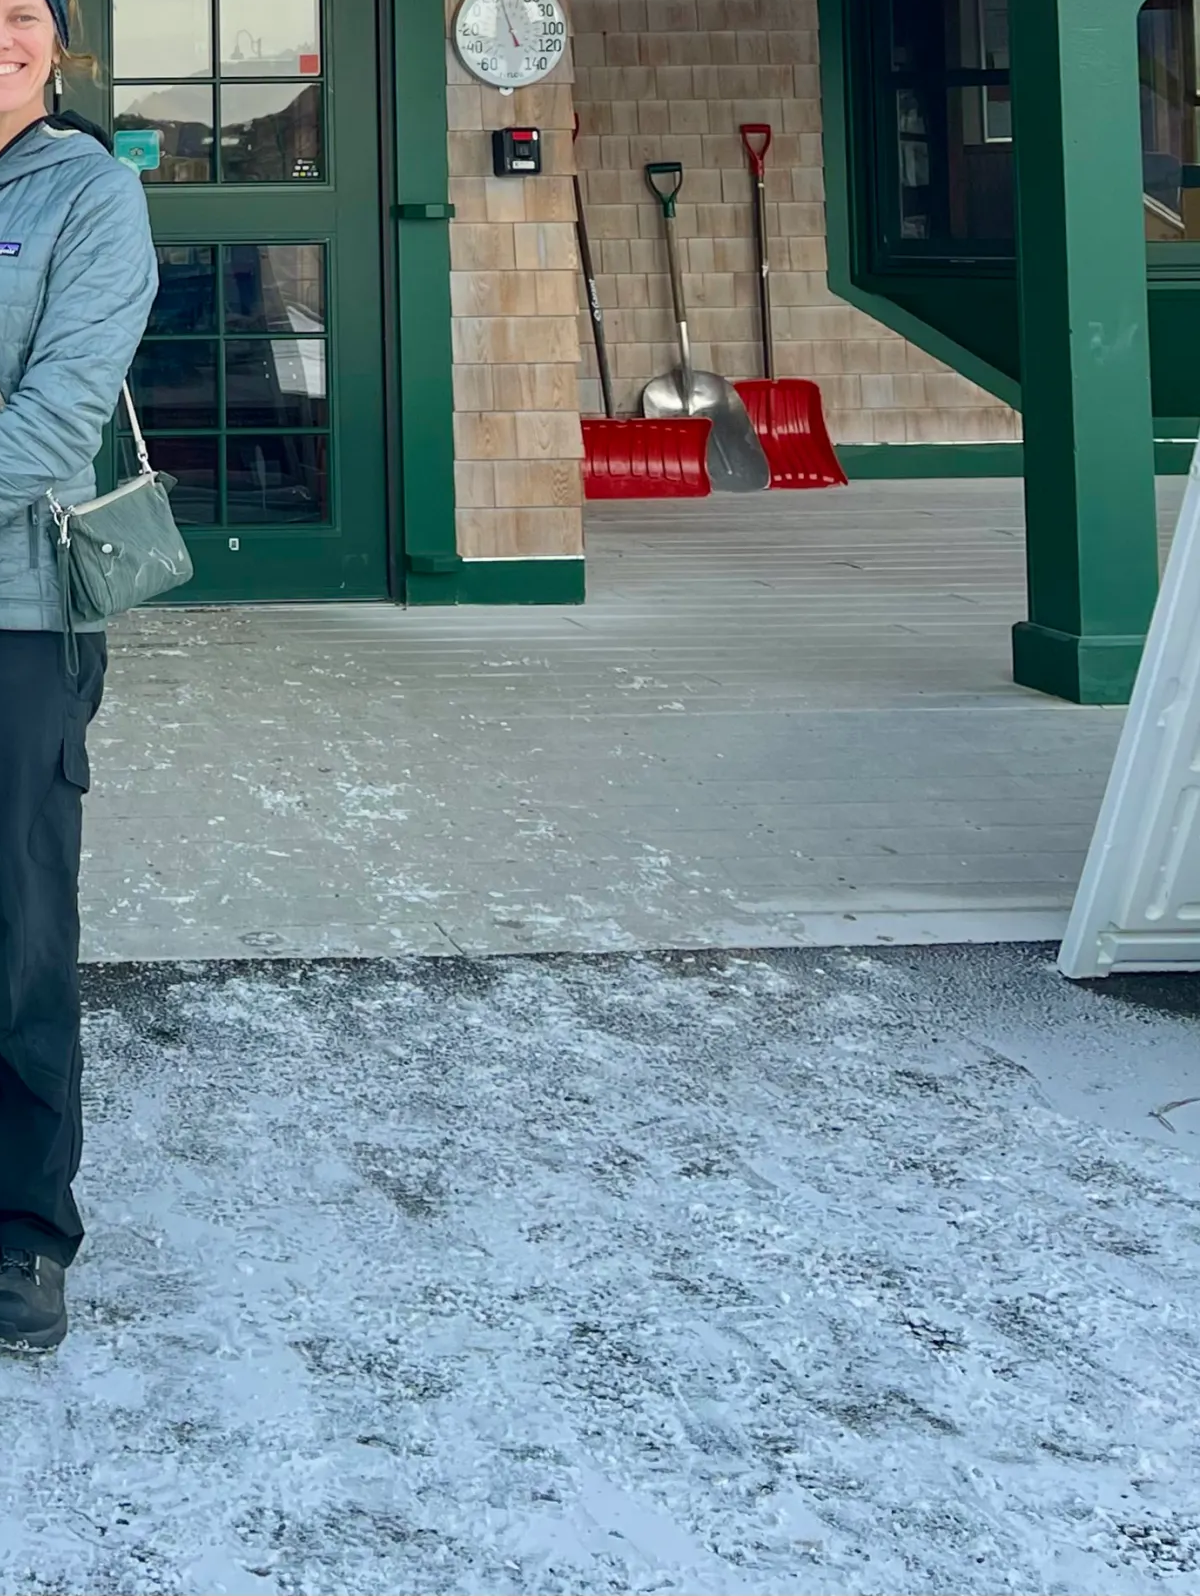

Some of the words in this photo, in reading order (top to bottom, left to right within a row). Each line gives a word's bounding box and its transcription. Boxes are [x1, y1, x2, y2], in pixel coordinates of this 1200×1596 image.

[542, 22, 564, 35] 100
[538, 39, 562, 52] 120
[476, 57, 498, 71] -60
[525, 57, 547, 71] 140
